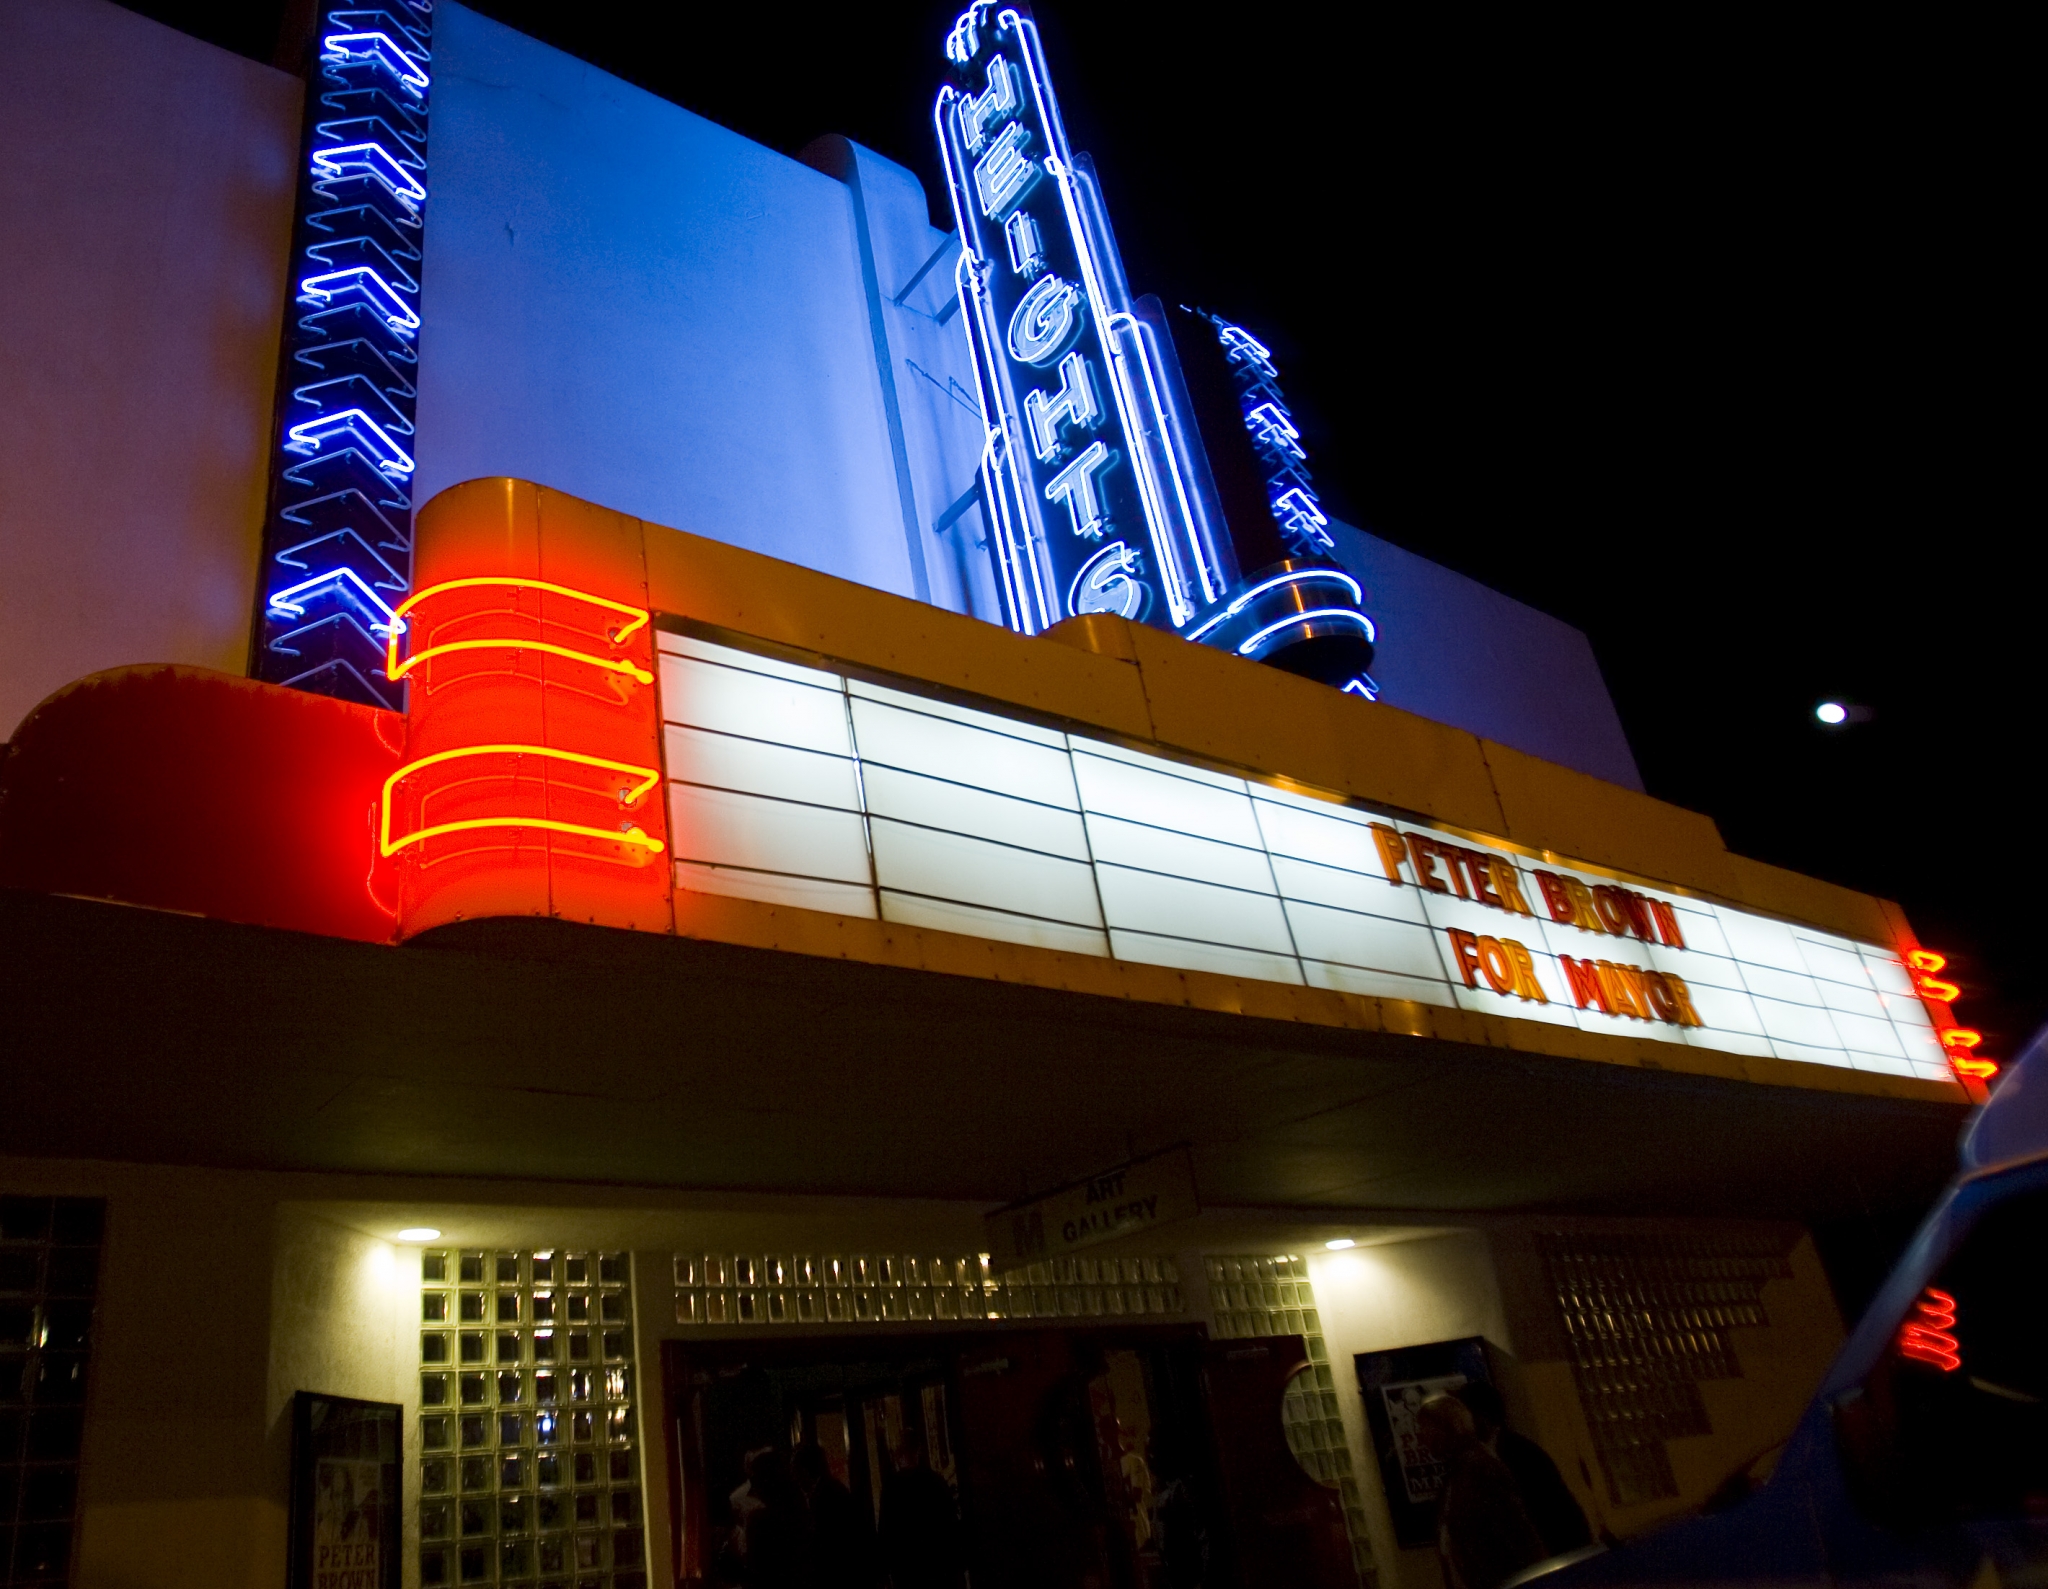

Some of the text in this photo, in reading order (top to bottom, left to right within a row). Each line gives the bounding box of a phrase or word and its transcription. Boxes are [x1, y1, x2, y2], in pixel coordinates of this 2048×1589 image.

[958, 54, 1142, 617] HEIGHTS
[1368, 822, 1686, 949] PETER BROWN
[1446, 927, 1704, 1028] FOR MAYOR
[1062, 1195, 1159, 1244] GALLERY
[1086, 1170, 1125, 1206] ART
[318, 1544, 376, 1569] PETER
